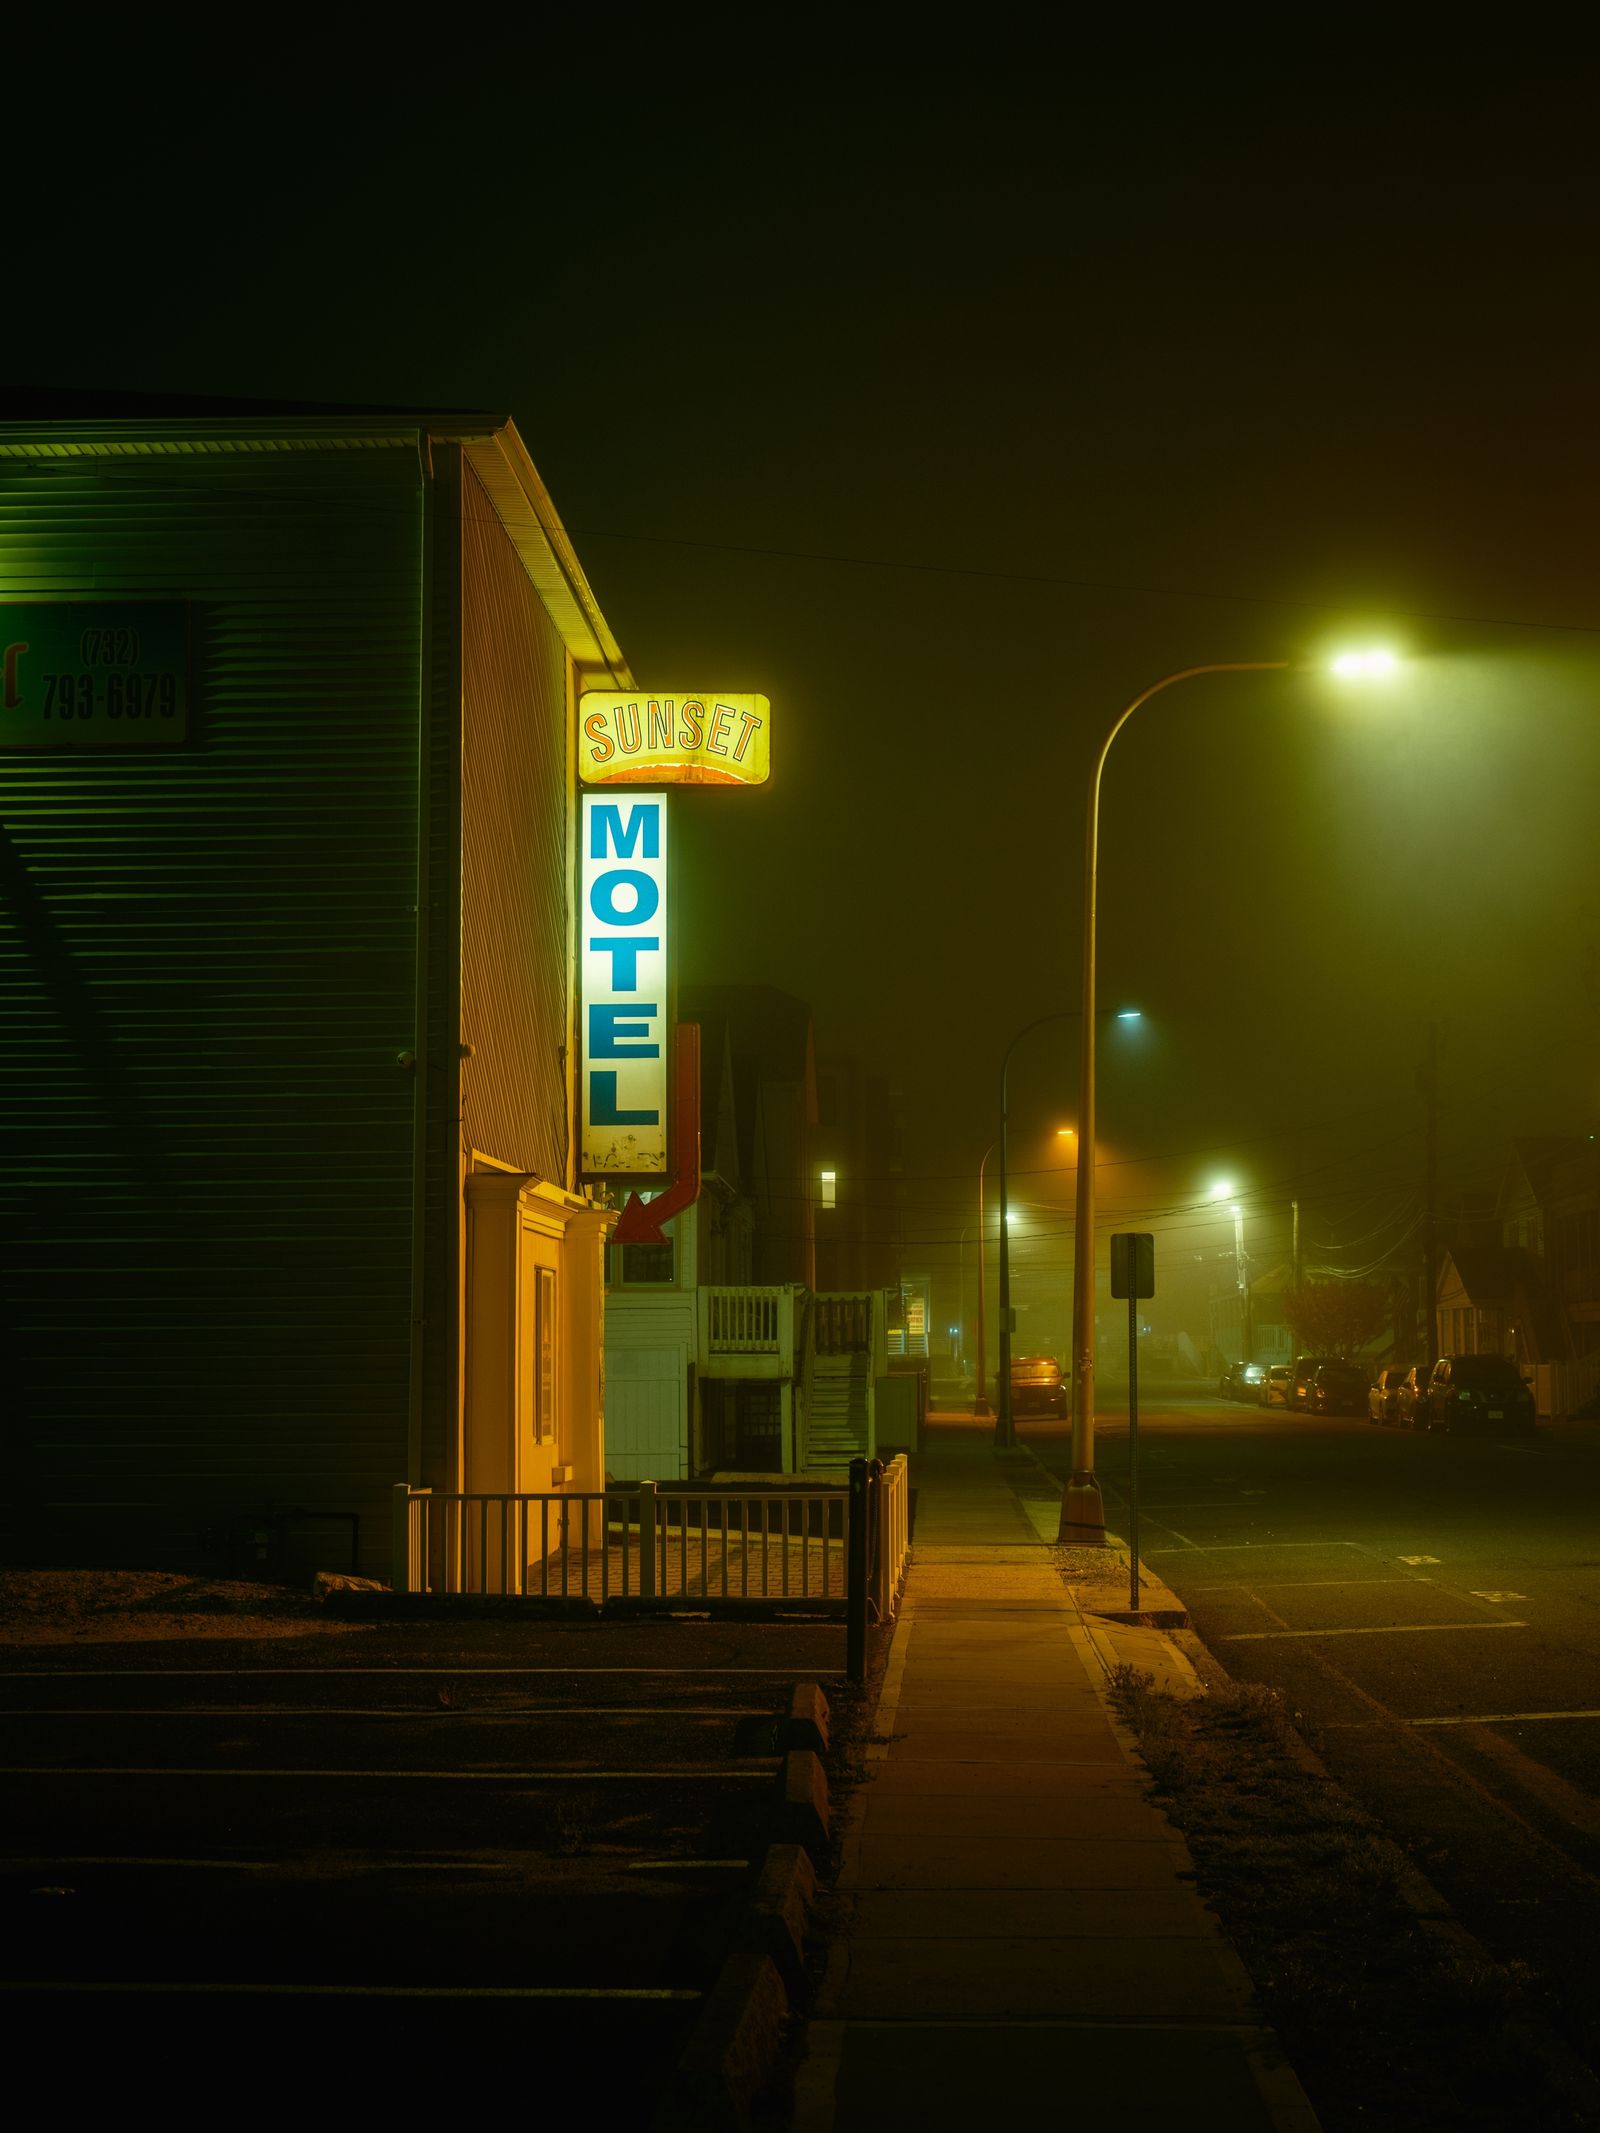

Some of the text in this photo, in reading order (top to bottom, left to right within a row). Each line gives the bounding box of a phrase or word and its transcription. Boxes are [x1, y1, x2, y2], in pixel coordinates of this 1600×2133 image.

[81, 626, 140, 668] (732)
[43, 673, 176, 720] 793-6979
[584, 700, 763, 762] SUNSET
[588, 803, 660, 1126] MOTEL
